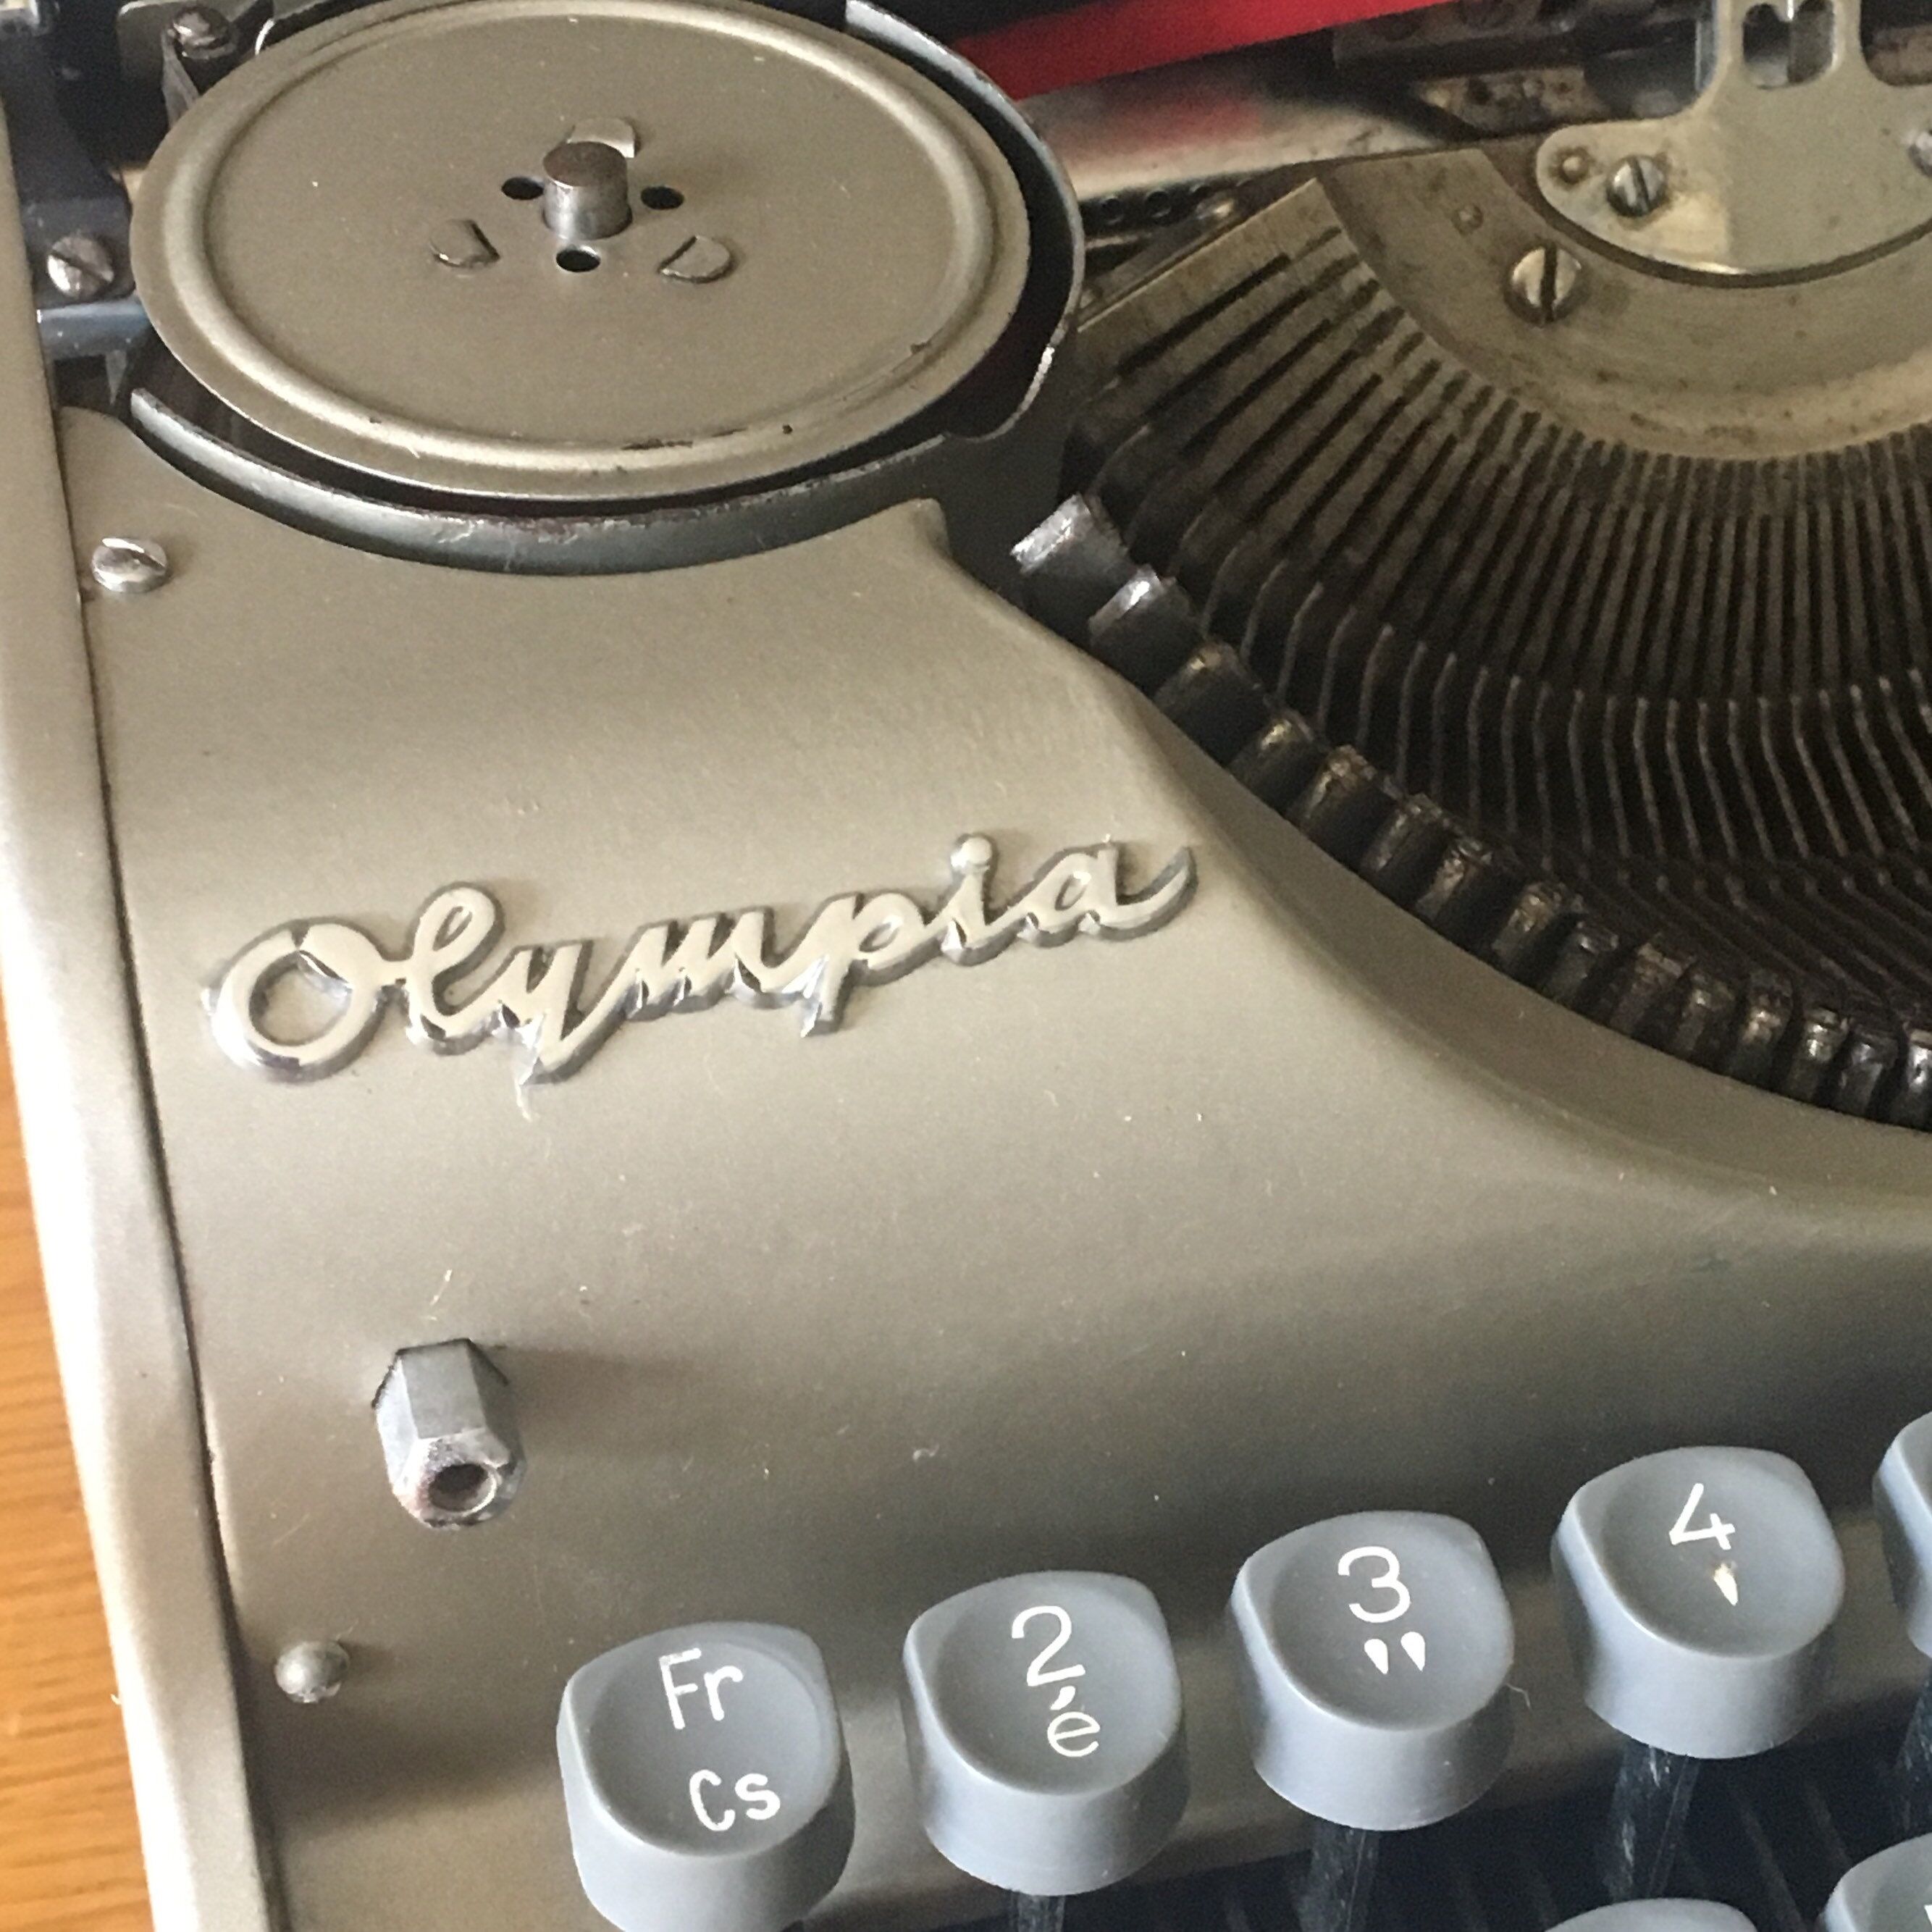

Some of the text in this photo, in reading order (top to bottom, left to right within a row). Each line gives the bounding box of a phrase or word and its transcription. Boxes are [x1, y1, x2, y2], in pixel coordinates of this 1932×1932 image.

[203, 833, 1197, 1084] Olympia
[1668, 1482, 1736, 1550] 4
[1337, 1545, 1411, 1624] 3
[1011, 1605, 1086, 1687] 2
[658, 1647, 745, 1730] Fr
